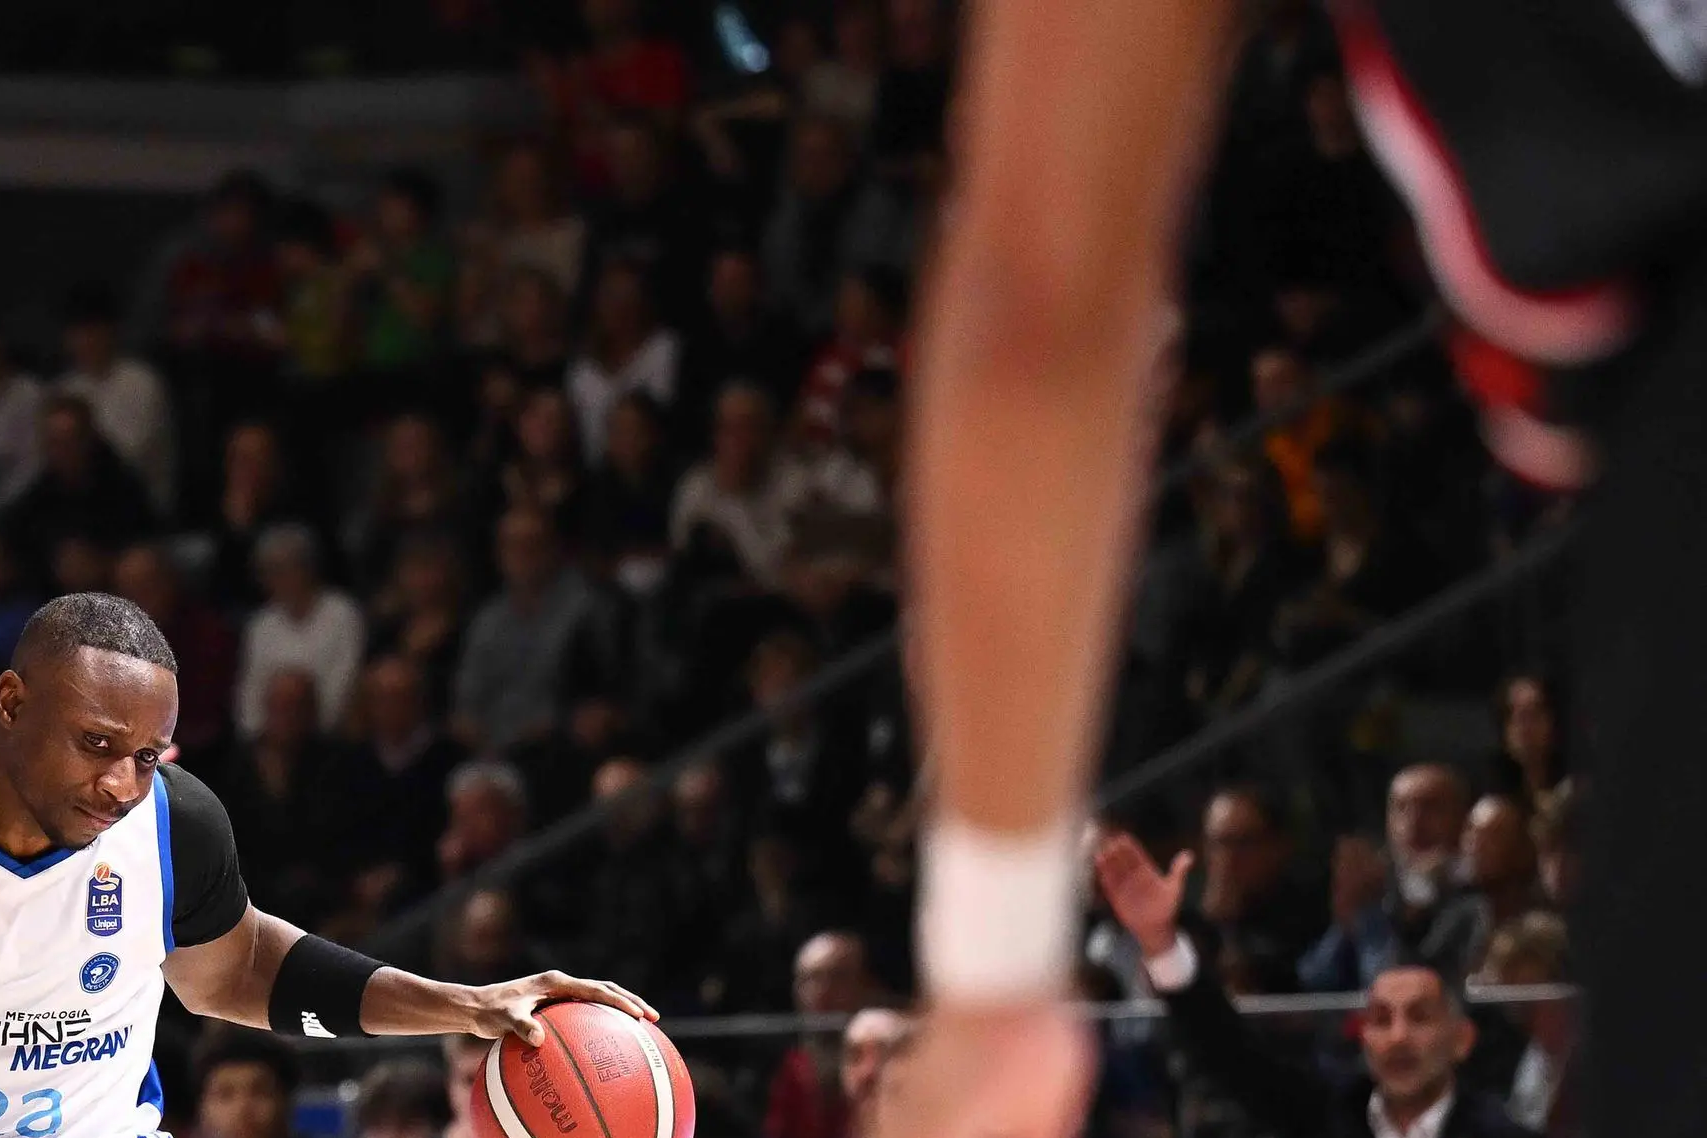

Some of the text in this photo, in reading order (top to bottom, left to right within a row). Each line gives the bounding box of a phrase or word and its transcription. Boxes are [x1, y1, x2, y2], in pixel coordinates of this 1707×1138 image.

[92, 894, 119, 907] LBA
[94, 919, 118, 930] Unipol
[5, 1009, 90, 1021] METROLOGIA
